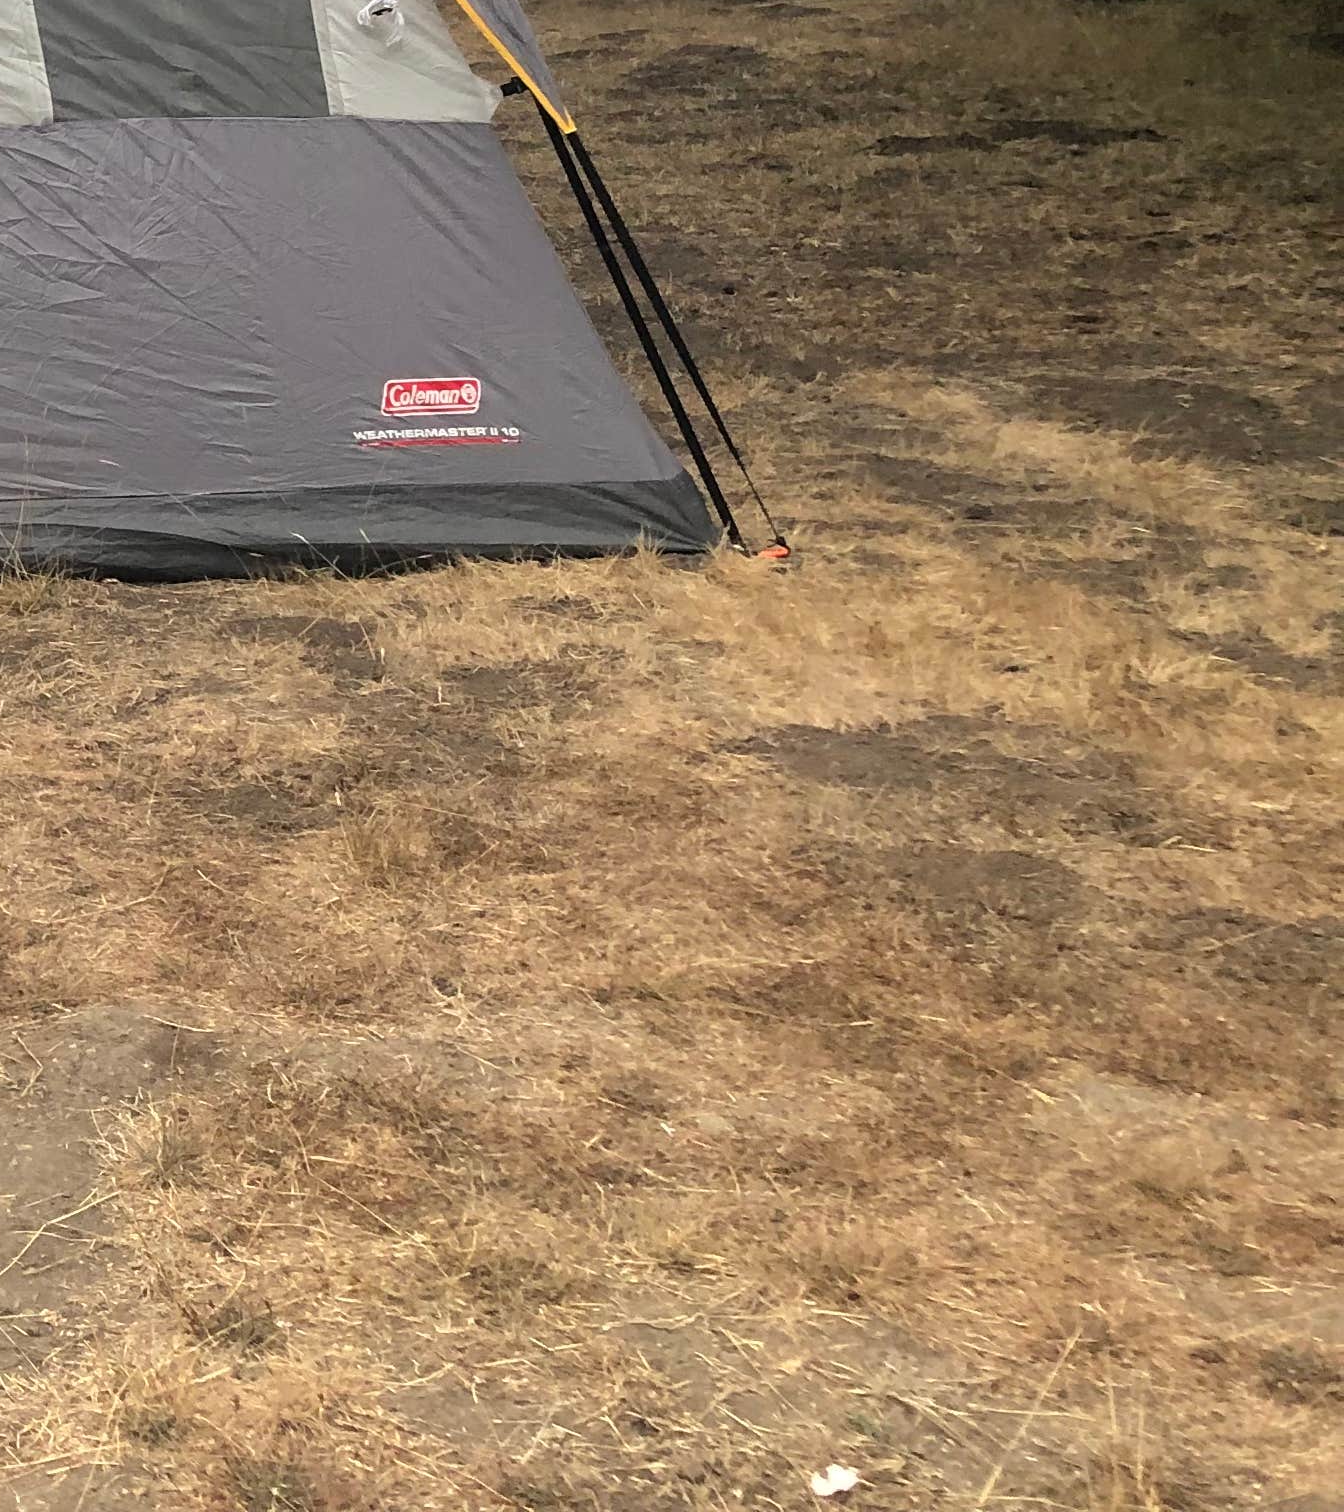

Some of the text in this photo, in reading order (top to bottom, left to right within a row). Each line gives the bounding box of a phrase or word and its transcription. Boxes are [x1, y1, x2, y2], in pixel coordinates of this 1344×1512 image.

[389, 385, 460, 407] Coleman
[353, 427, 486, 440] WEATHERMASTER
[502, 427, 520, 437] 10
